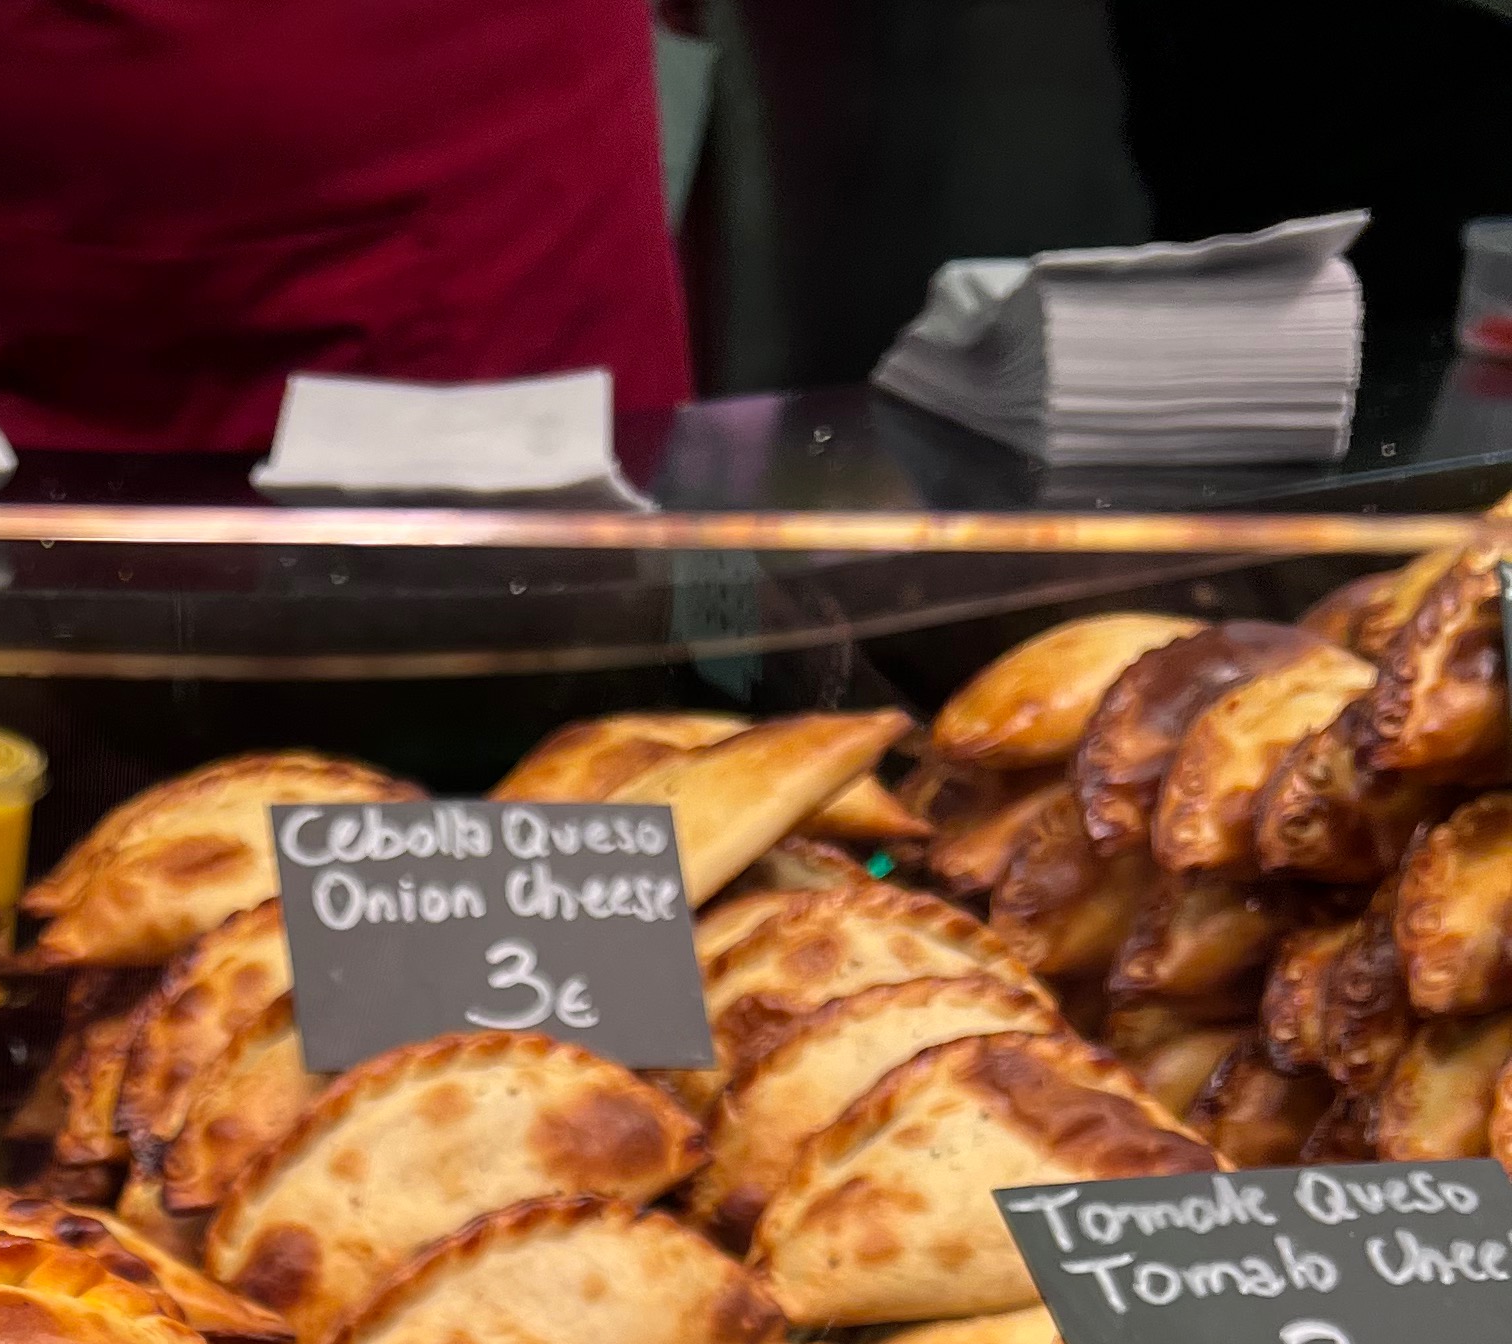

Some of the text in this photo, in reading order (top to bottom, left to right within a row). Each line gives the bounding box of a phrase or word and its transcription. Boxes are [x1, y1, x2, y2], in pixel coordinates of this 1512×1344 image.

[280, 804, 669, 867] Cebolla Queso
[311, 860, 680, 931] Onion Cheese
[1007, 1168, 1480, 1252] Tomate Queso
[1059, 1227, 1512, 1315] Tomato Chee
